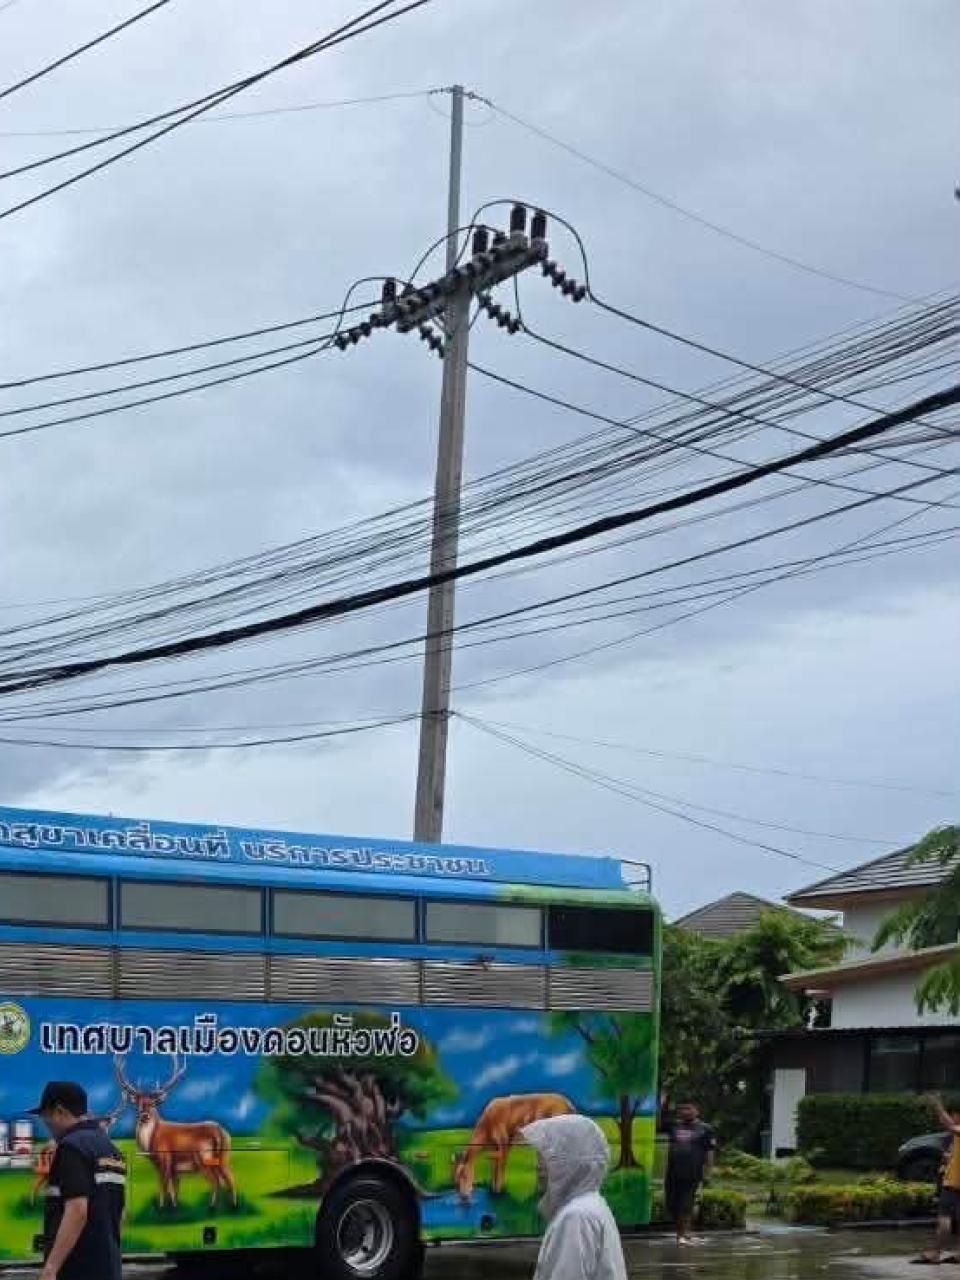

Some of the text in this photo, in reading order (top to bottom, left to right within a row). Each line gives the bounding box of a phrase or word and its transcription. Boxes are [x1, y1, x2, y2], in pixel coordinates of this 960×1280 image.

[241, 839, 489, 875] บริการประชาชน
